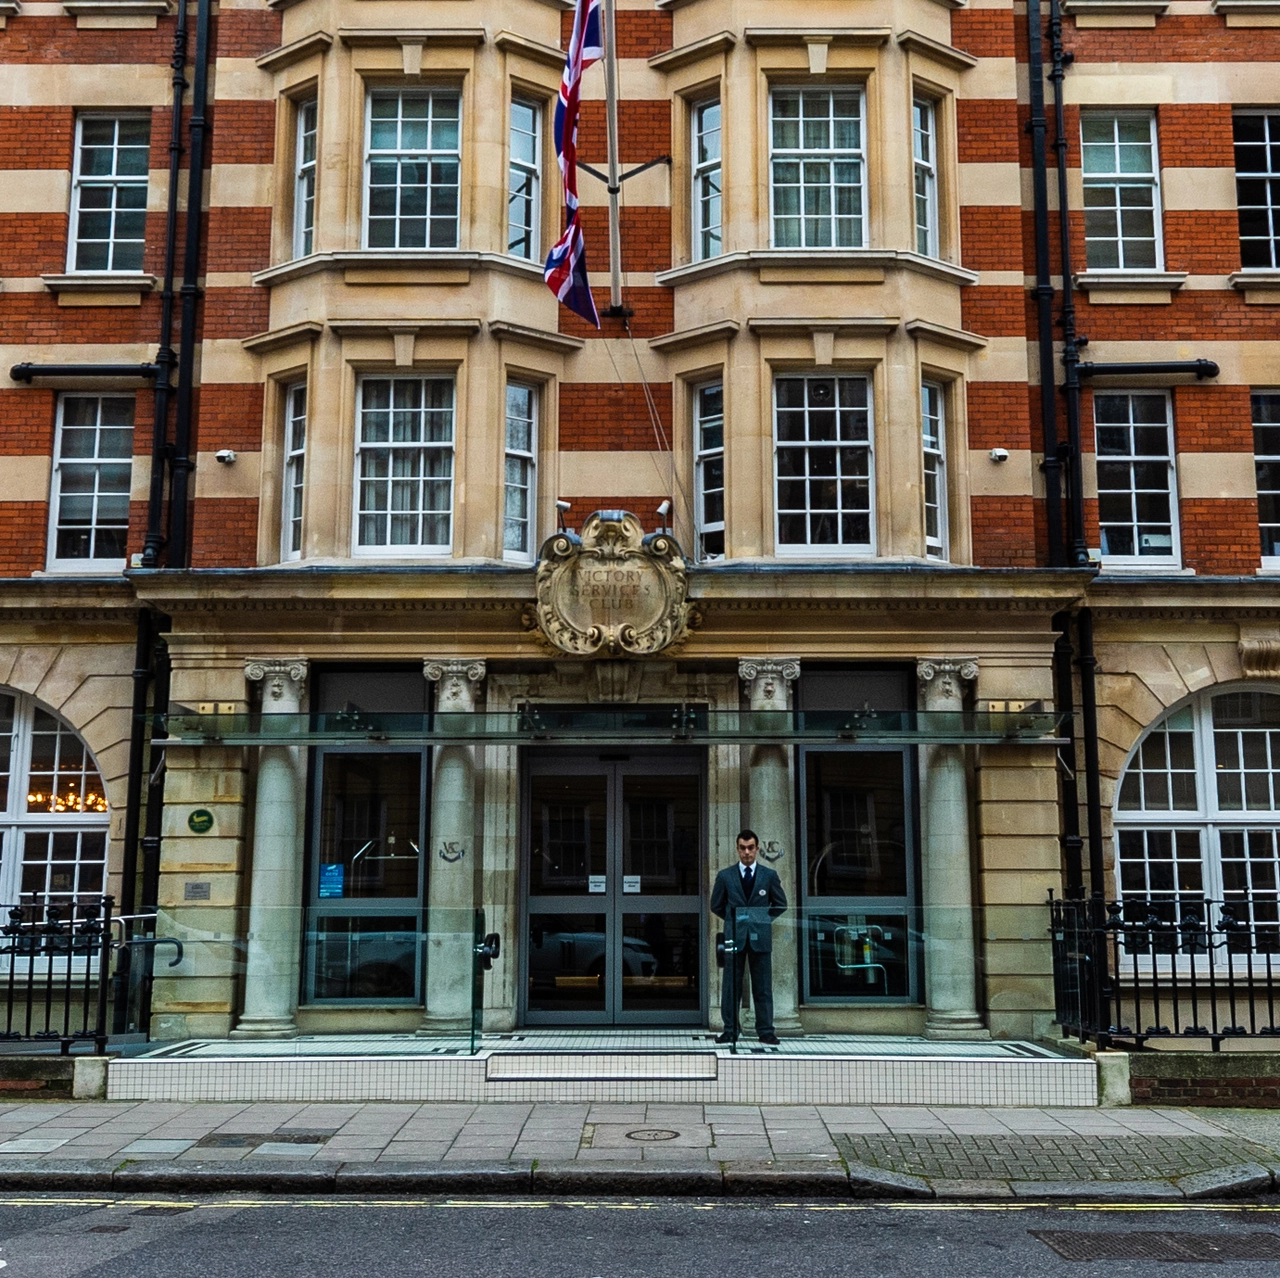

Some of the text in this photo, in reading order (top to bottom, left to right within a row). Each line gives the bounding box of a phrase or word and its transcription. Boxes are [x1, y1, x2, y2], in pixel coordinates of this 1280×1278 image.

[577, 570, 645, 582] VICTORY
[570, 584, 651, 597] SERVICES
[589, 598, 634, 610] CLUB
